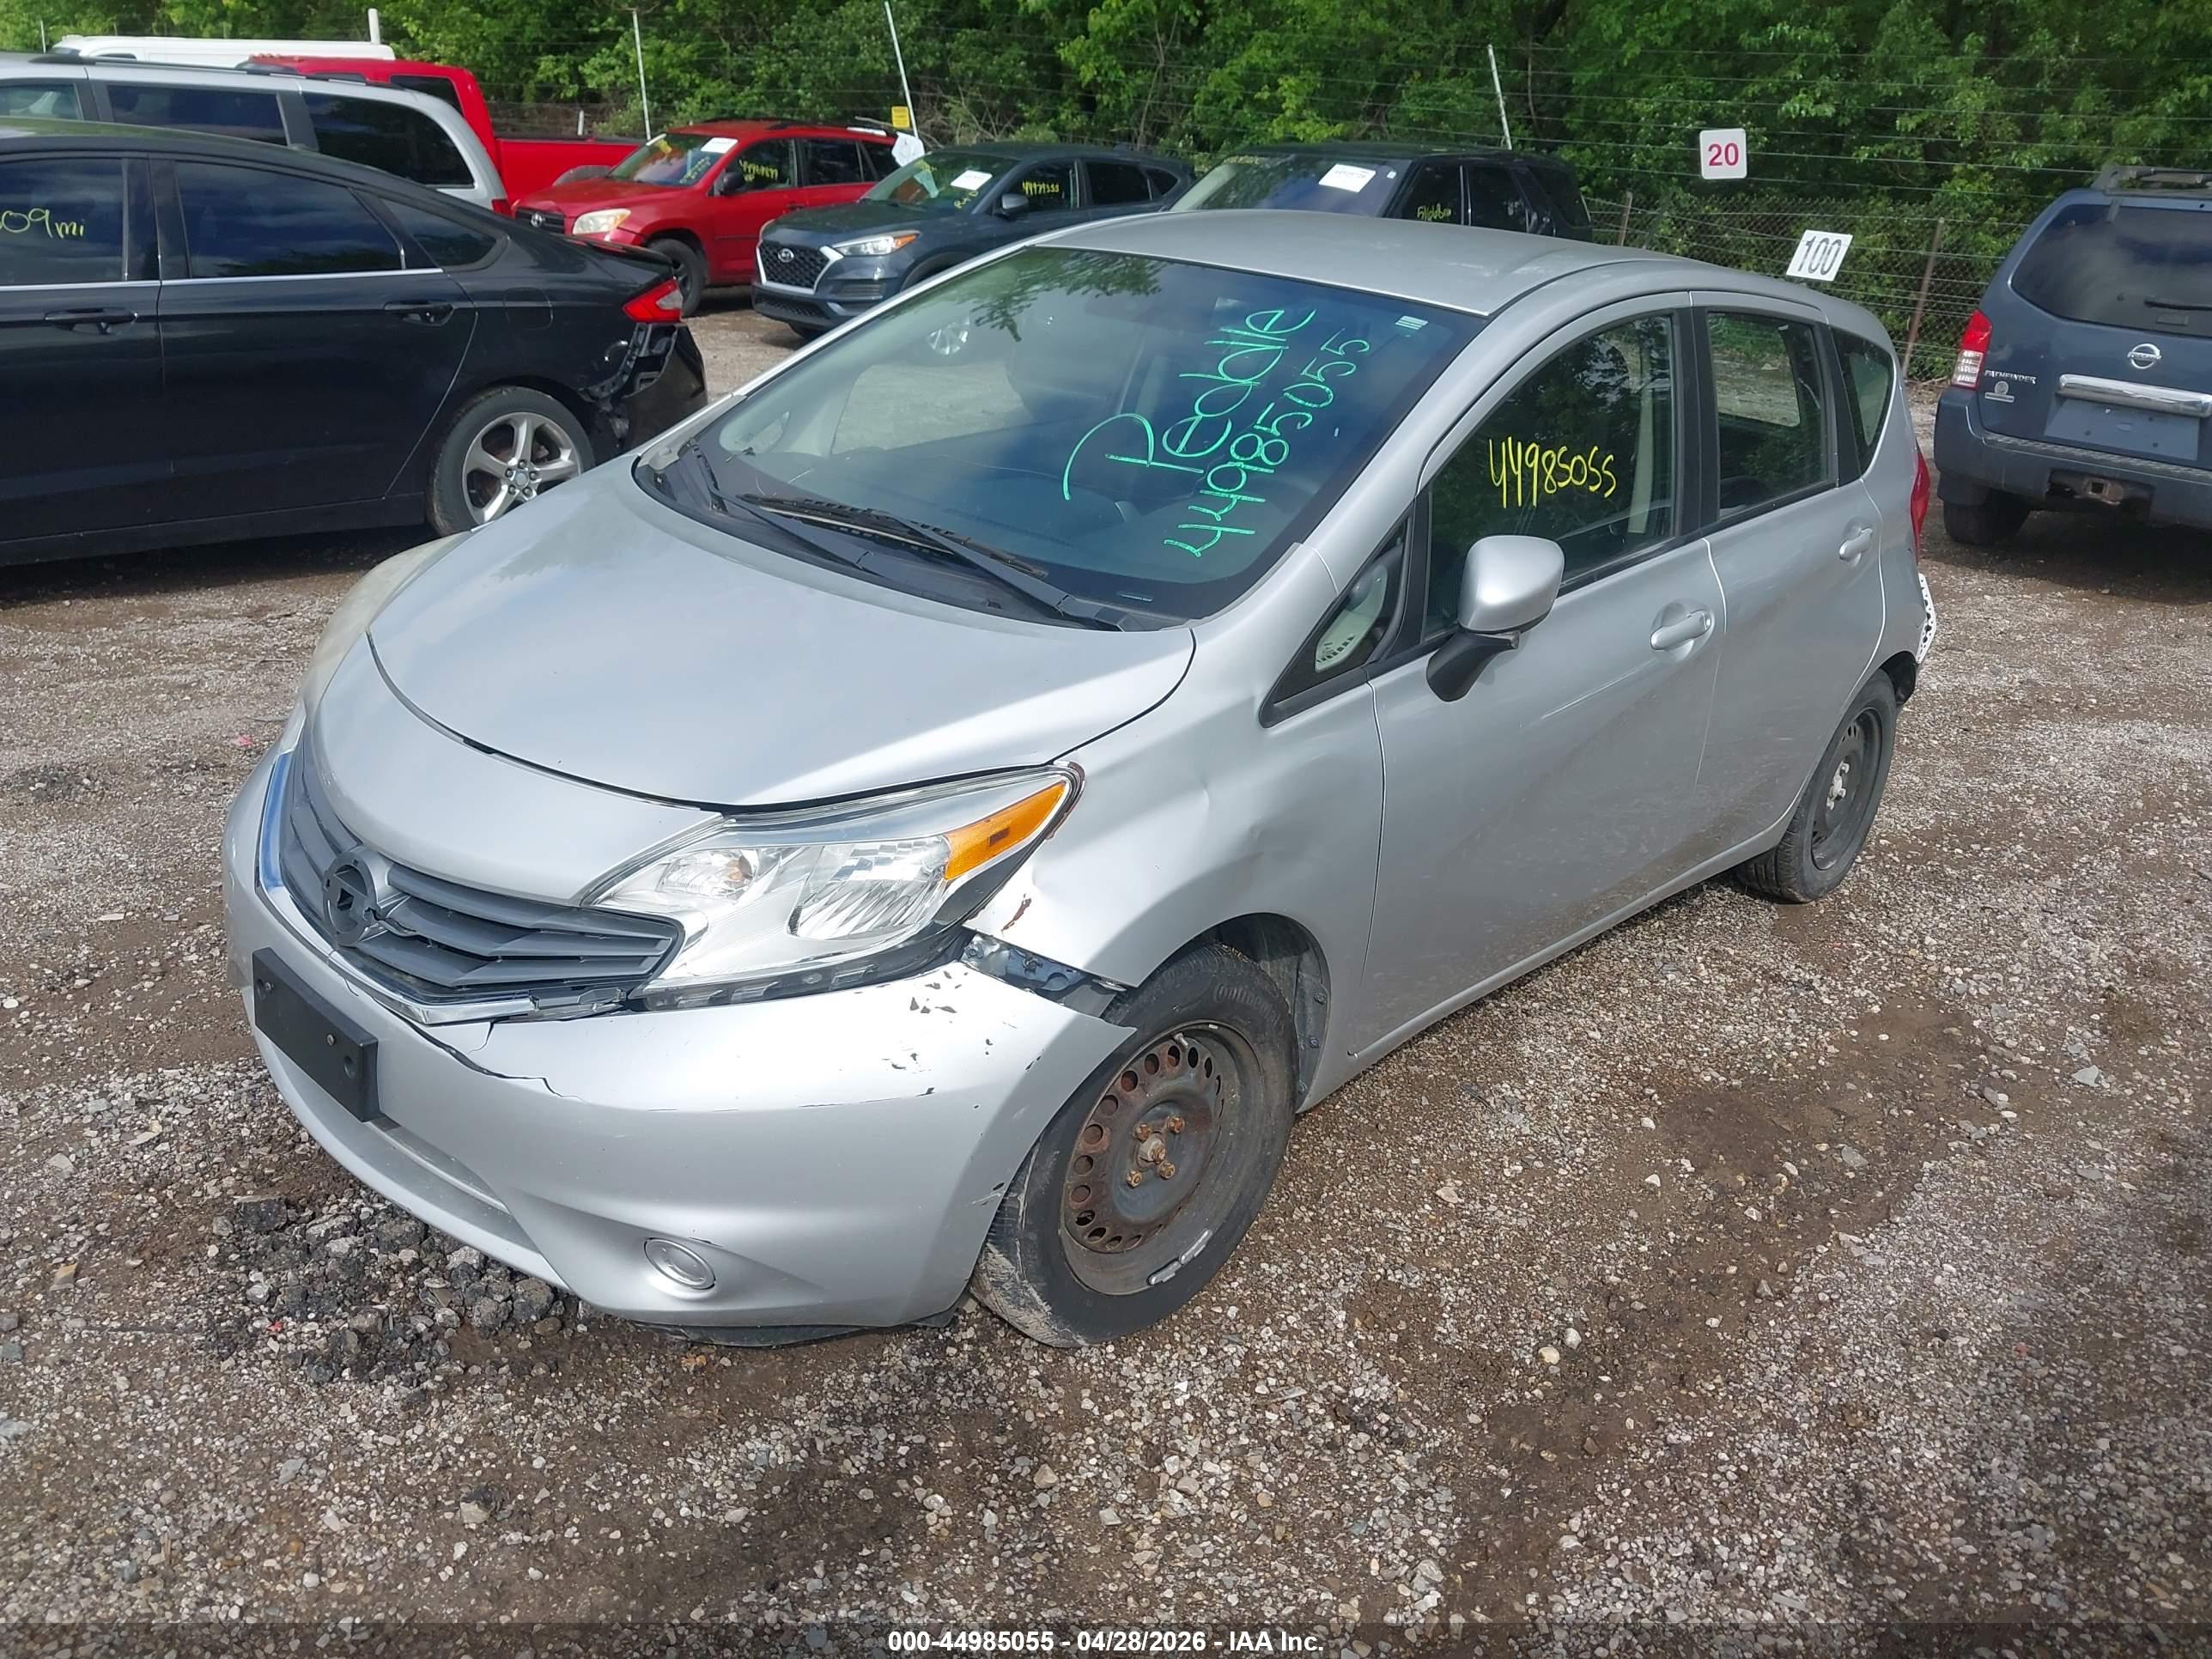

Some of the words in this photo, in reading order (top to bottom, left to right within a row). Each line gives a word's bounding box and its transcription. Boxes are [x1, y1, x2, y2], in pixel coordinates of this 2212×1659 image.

[1708, 143, 1739, 166] 20
[1797, 236, 1842, 276] 100
[1984, 369, 2037, 384] PATHFINDER
[1164, 328, 1370, 557] 44985055
[1489, 436, 1617, 508] 44985055
